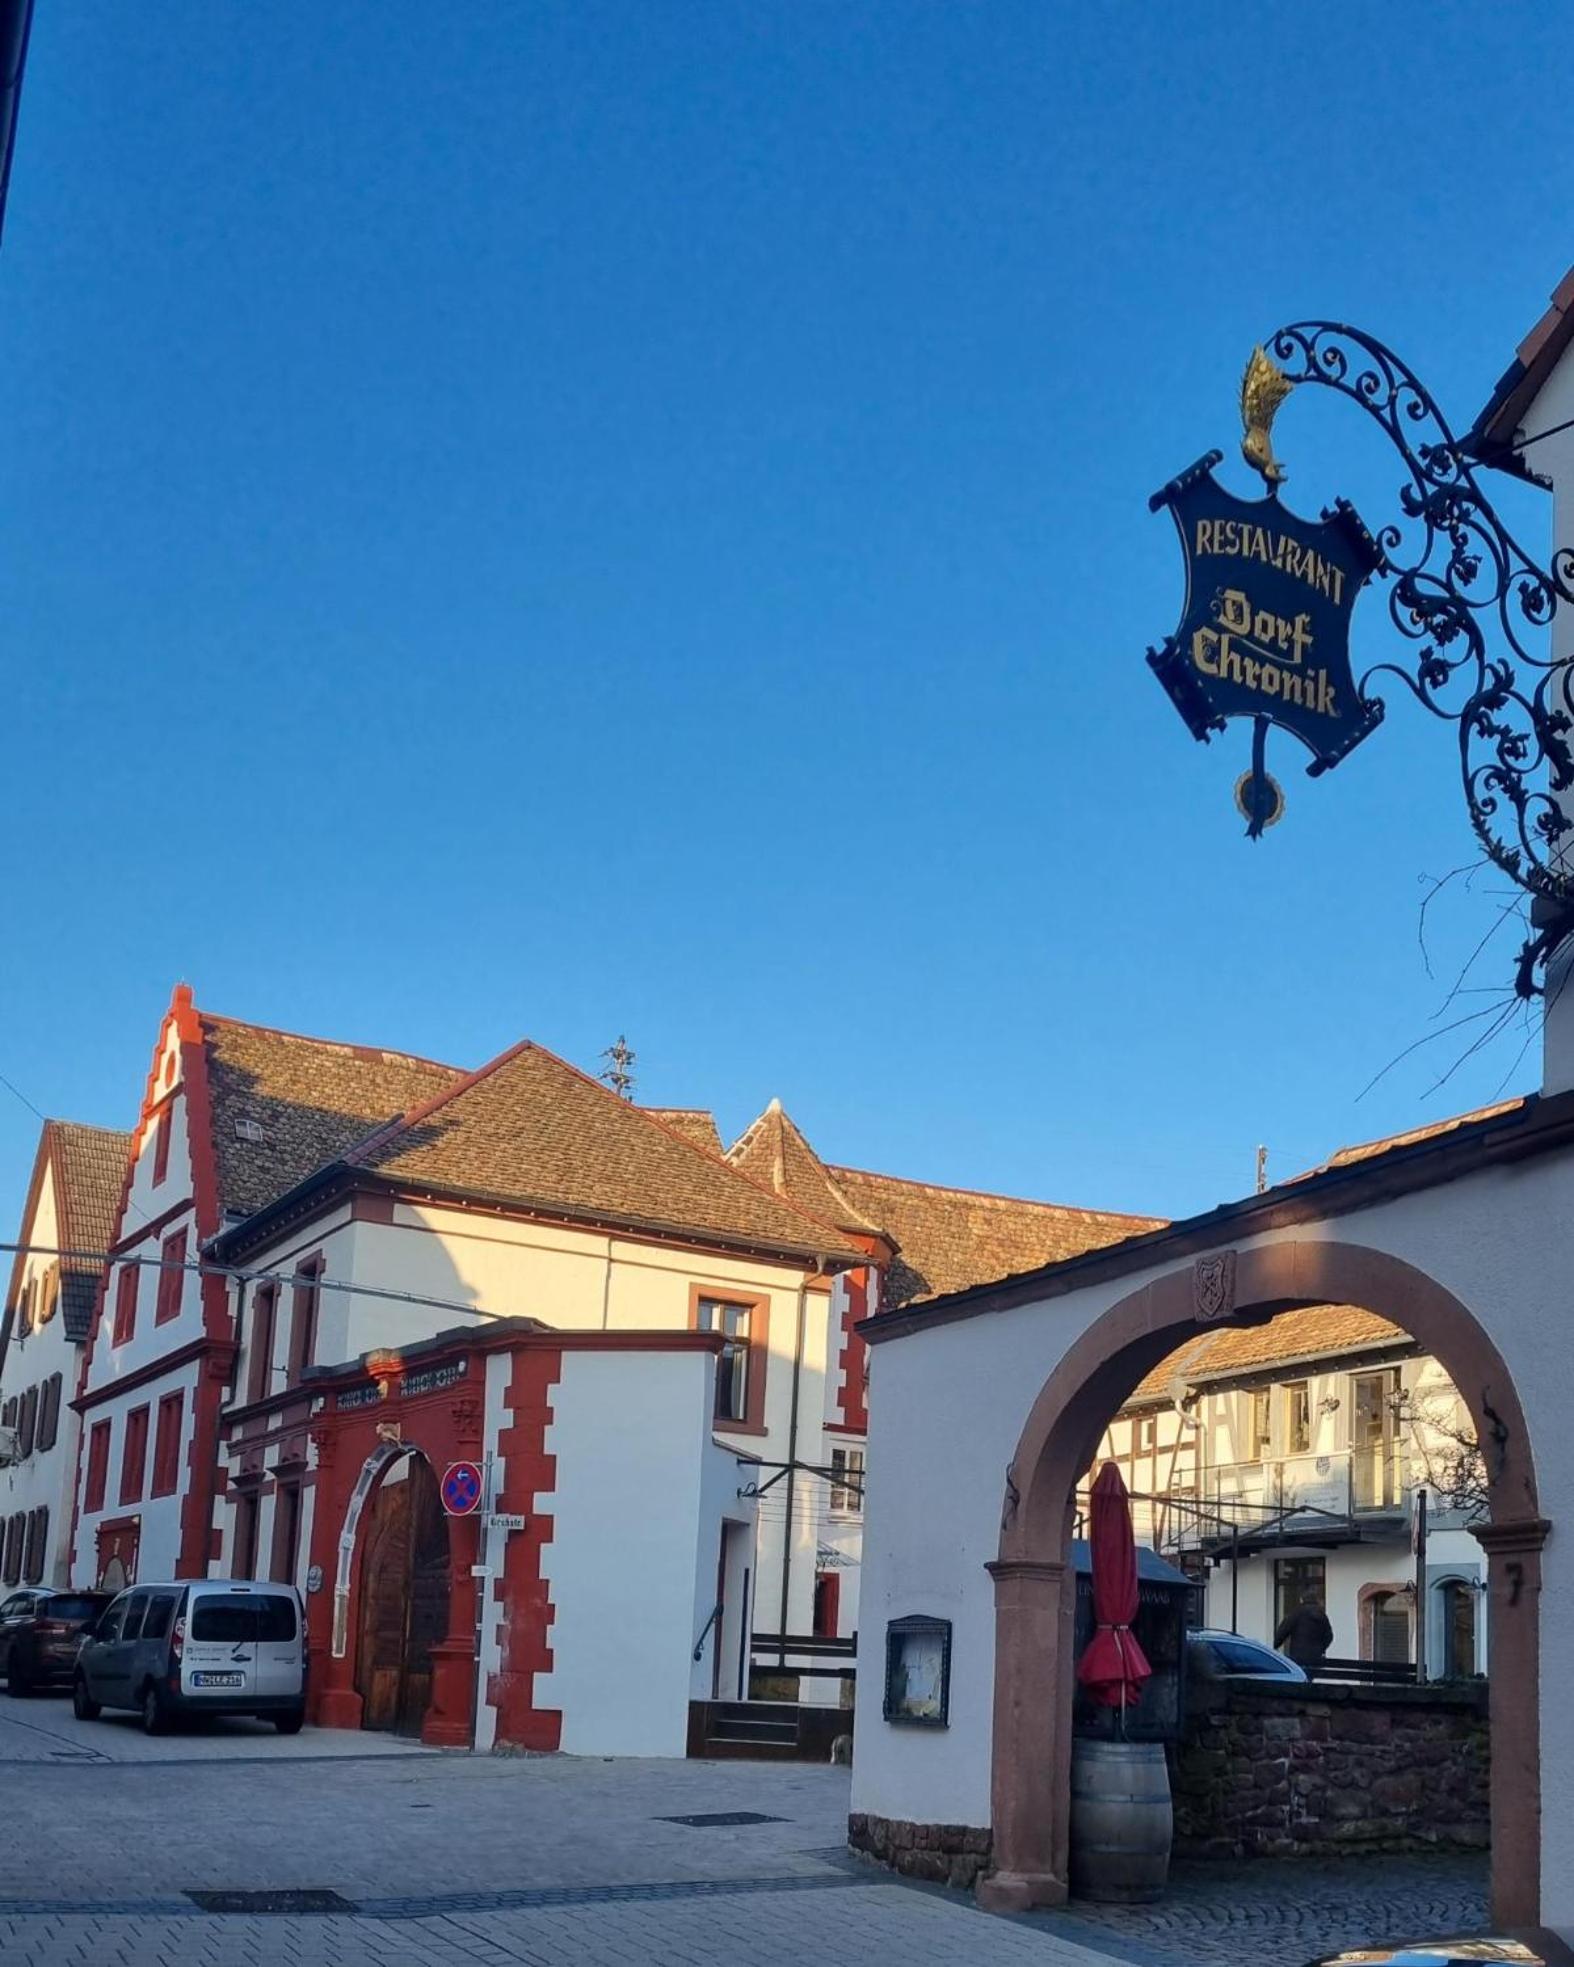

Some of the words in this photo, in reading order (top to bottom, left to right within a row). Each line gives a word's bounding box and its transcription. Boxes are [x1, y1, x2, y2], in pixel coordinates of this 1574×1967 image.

[1196, 519, 1345, 606] RESTAURANT
[1210, 587, 1314, 664] Dorf
[1193, 626, 1341, 718] Chronik
[1505, 1563, 1523, 1608] 7
